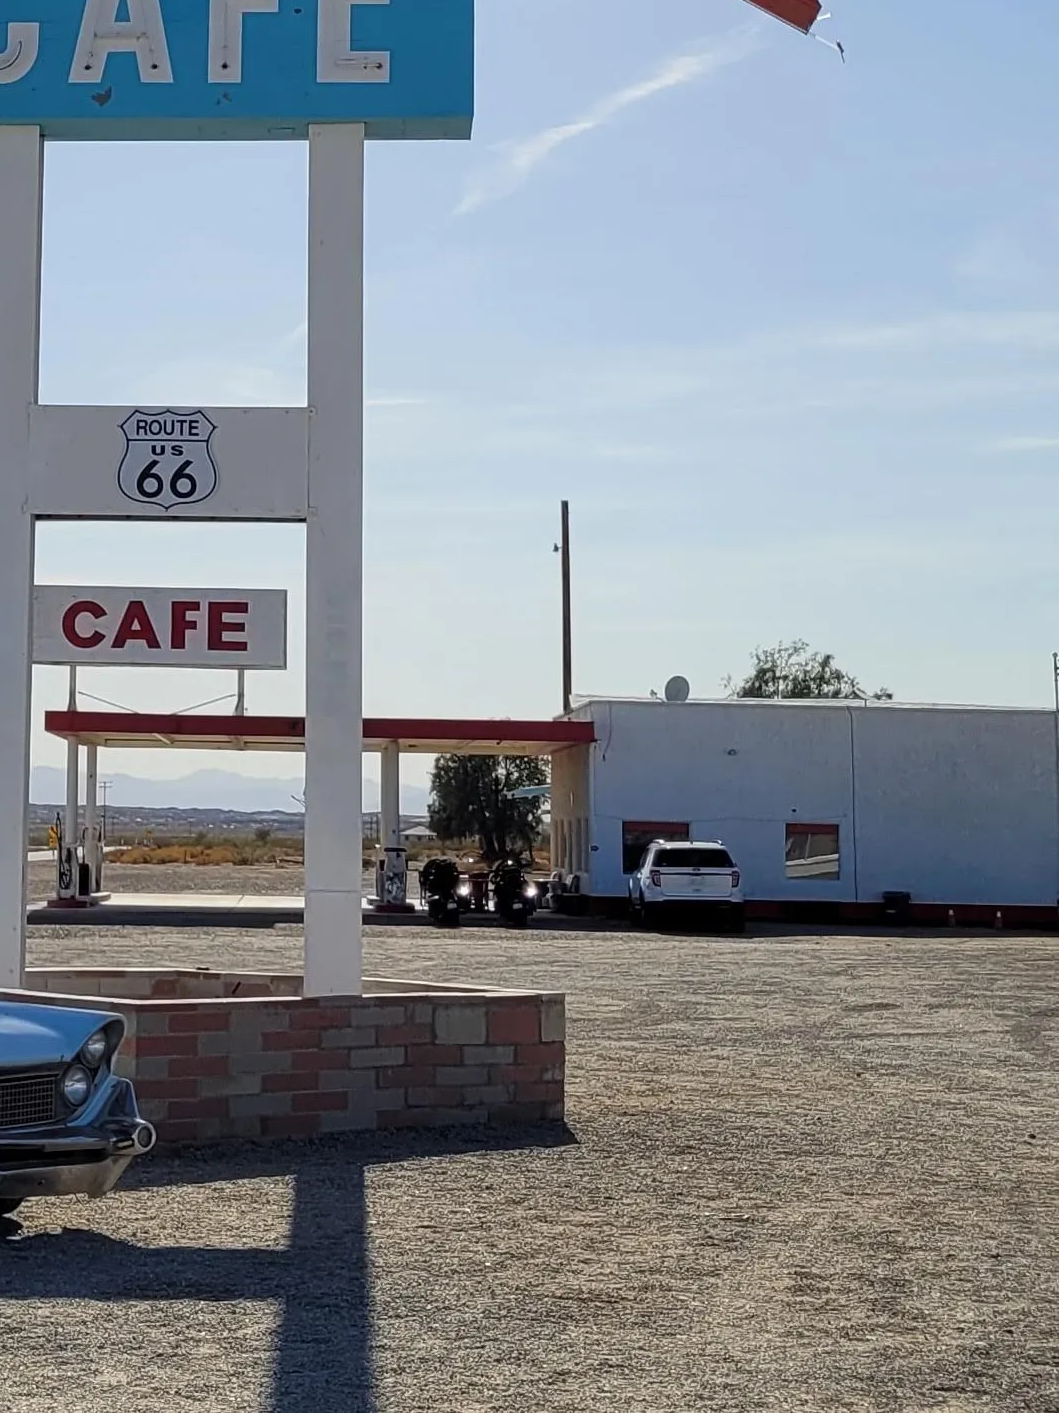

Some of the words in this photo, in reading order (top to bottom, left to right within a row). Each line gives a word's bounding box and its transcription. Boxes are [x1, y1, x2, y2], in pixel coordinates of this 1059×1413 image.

[135, 419, 200, 437] ROUTE
[150, 444, 185, 457] US
[135, 459, 198, 499] 66
[61, 600, 250, 652] CAFE
